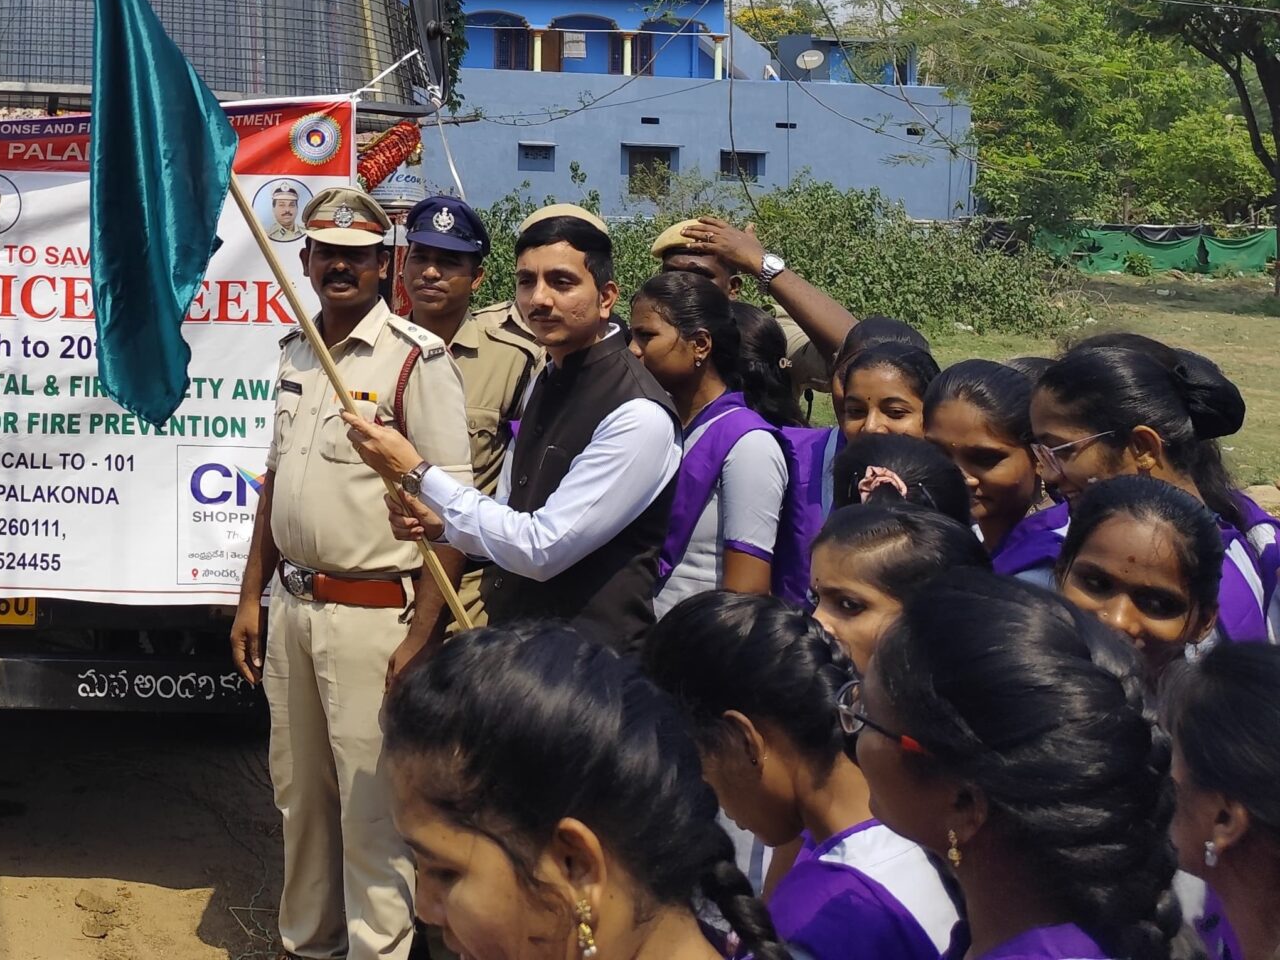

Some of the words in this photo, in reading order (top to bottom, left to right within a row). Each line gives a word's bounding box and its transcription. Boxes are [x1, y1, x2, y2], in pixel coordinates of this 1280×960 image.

[43, 123, 75, 135] AND
[78, 122, 91, 134] FI
[226, 113, 283, 127] RTMENT
[4, 244, 37, 264] TO
[45, 245, 90, 266] SAV
[185, 280, 297, 324] EEK
[21, 335, 50, 358] to
[59, 335, 94, 360] 20
[42, 374, 60, 397] &
[69, 375, 108, 398] FIR
[27, 412, 82, 435] FIRE
[2, 451, 54, 470] CALL
[59, 452, 85, 471] TO
[105, 454, 135, 472] 101
